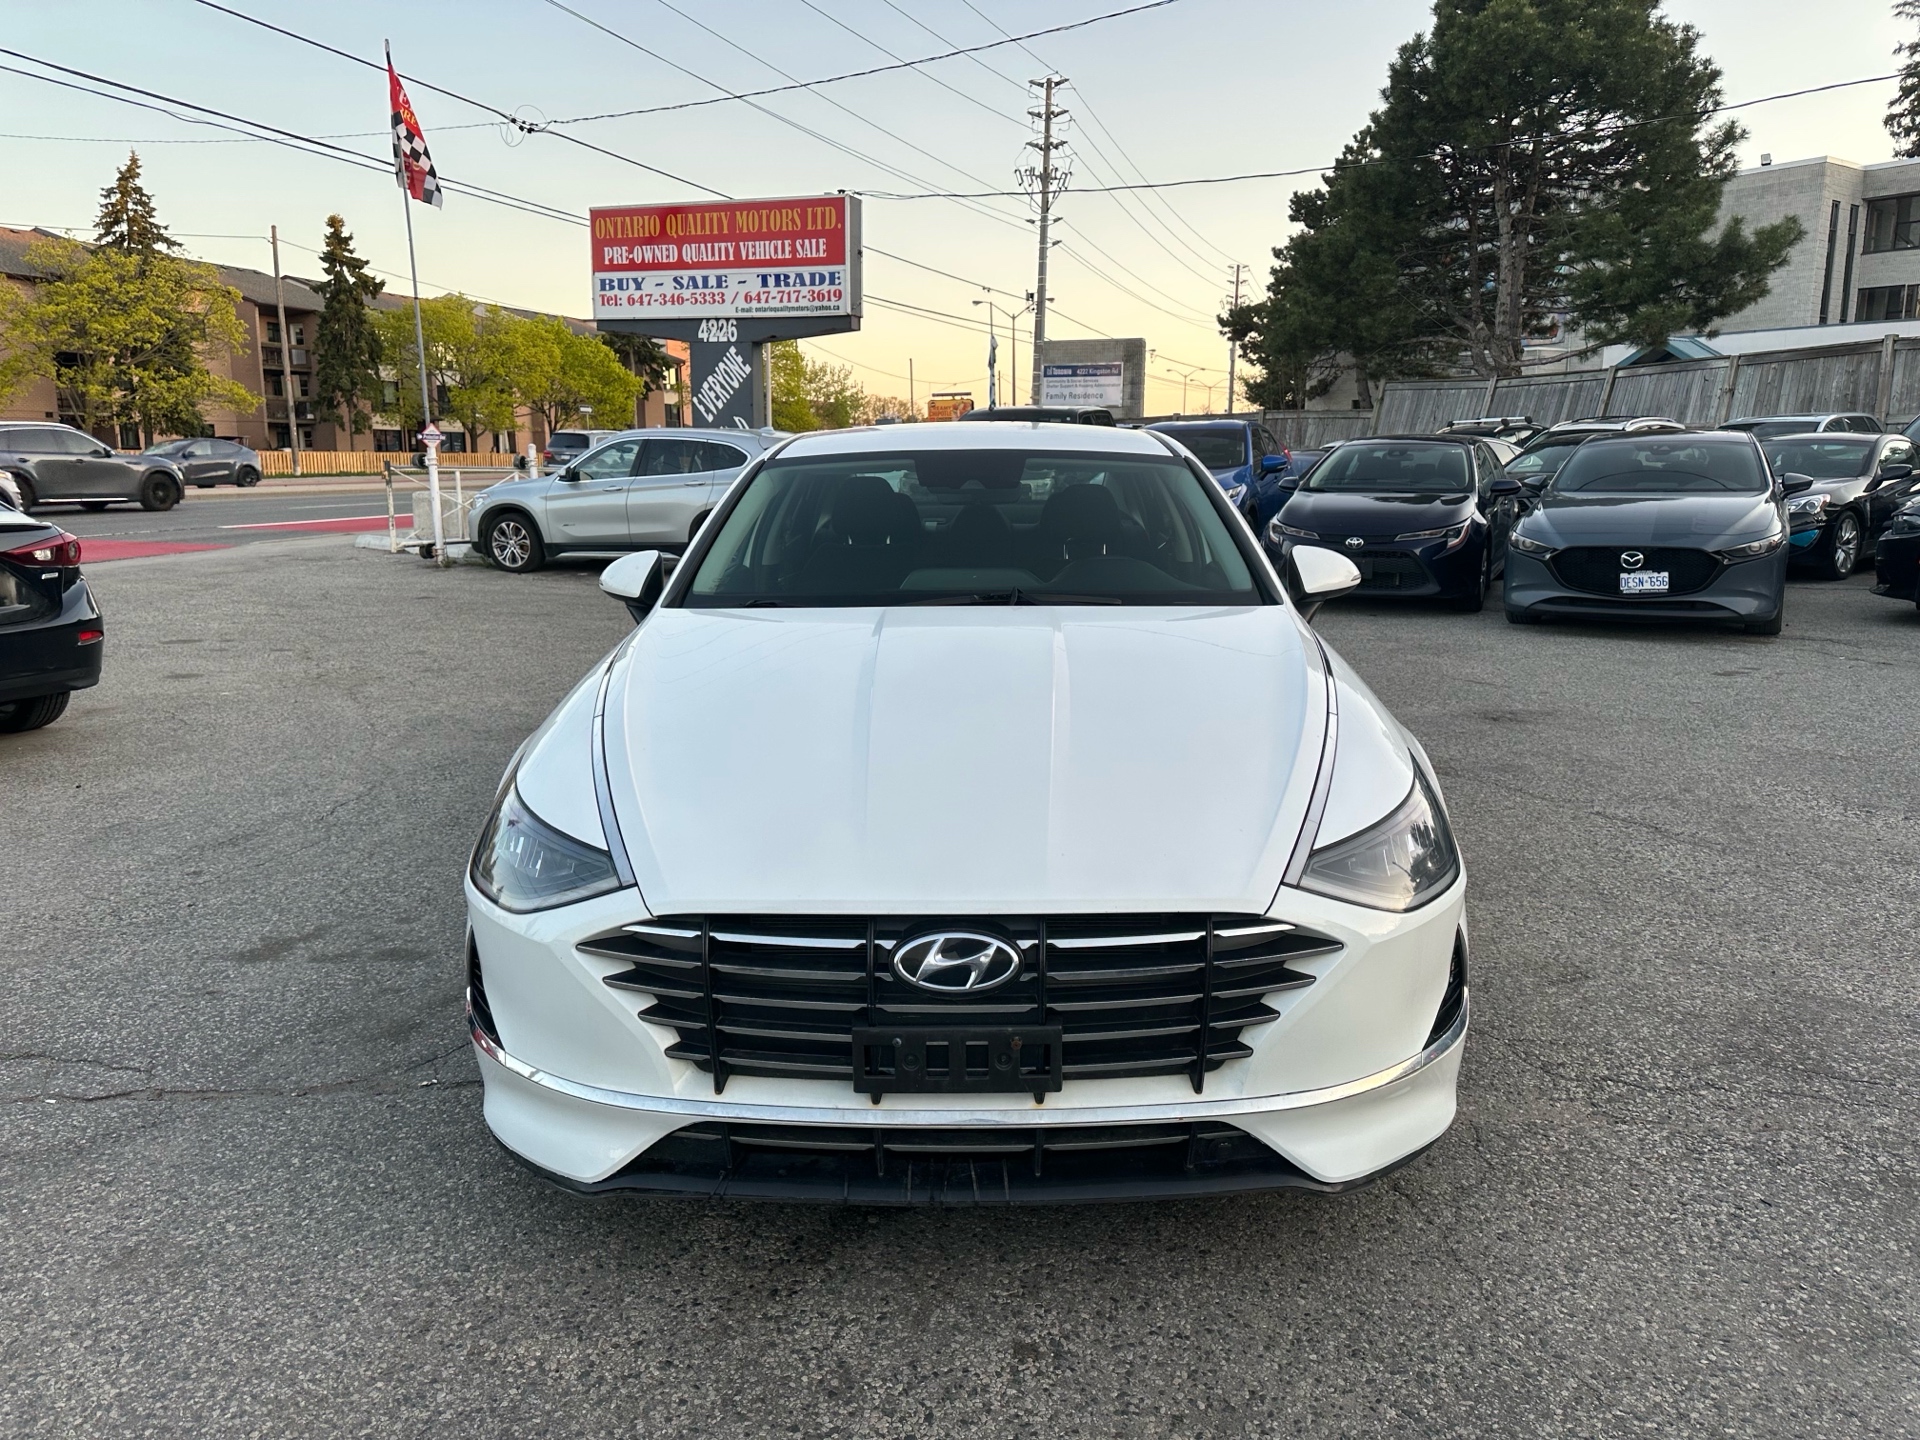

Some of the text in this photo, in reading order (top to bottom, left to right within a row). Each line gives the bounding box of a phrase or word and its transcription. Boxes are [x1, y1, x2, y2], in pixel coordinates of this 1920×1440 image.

[595, 206, 842, 239] ONTARIO QUALITY MOTORS LTD.
[604, 238, 827, 265] PRE-OWNED QUALITY VEHICLE SALE
[599, 277, 646, 292] BUY
[672, 275, 729, 290] SALE
[757, 271, 842, 288] TRADE
[599, 288, 843, 307] Tel: 647-346-5333 / 647-717-3619
[697, 319, 738, 342] 4226
[1089, 367, 1111, 376] Kingston
[1112, 367, 1119, 375] Rd
[692, 345, 752, 423] EVERYONE
[1045, 391, 1104, 401] Family Residence
